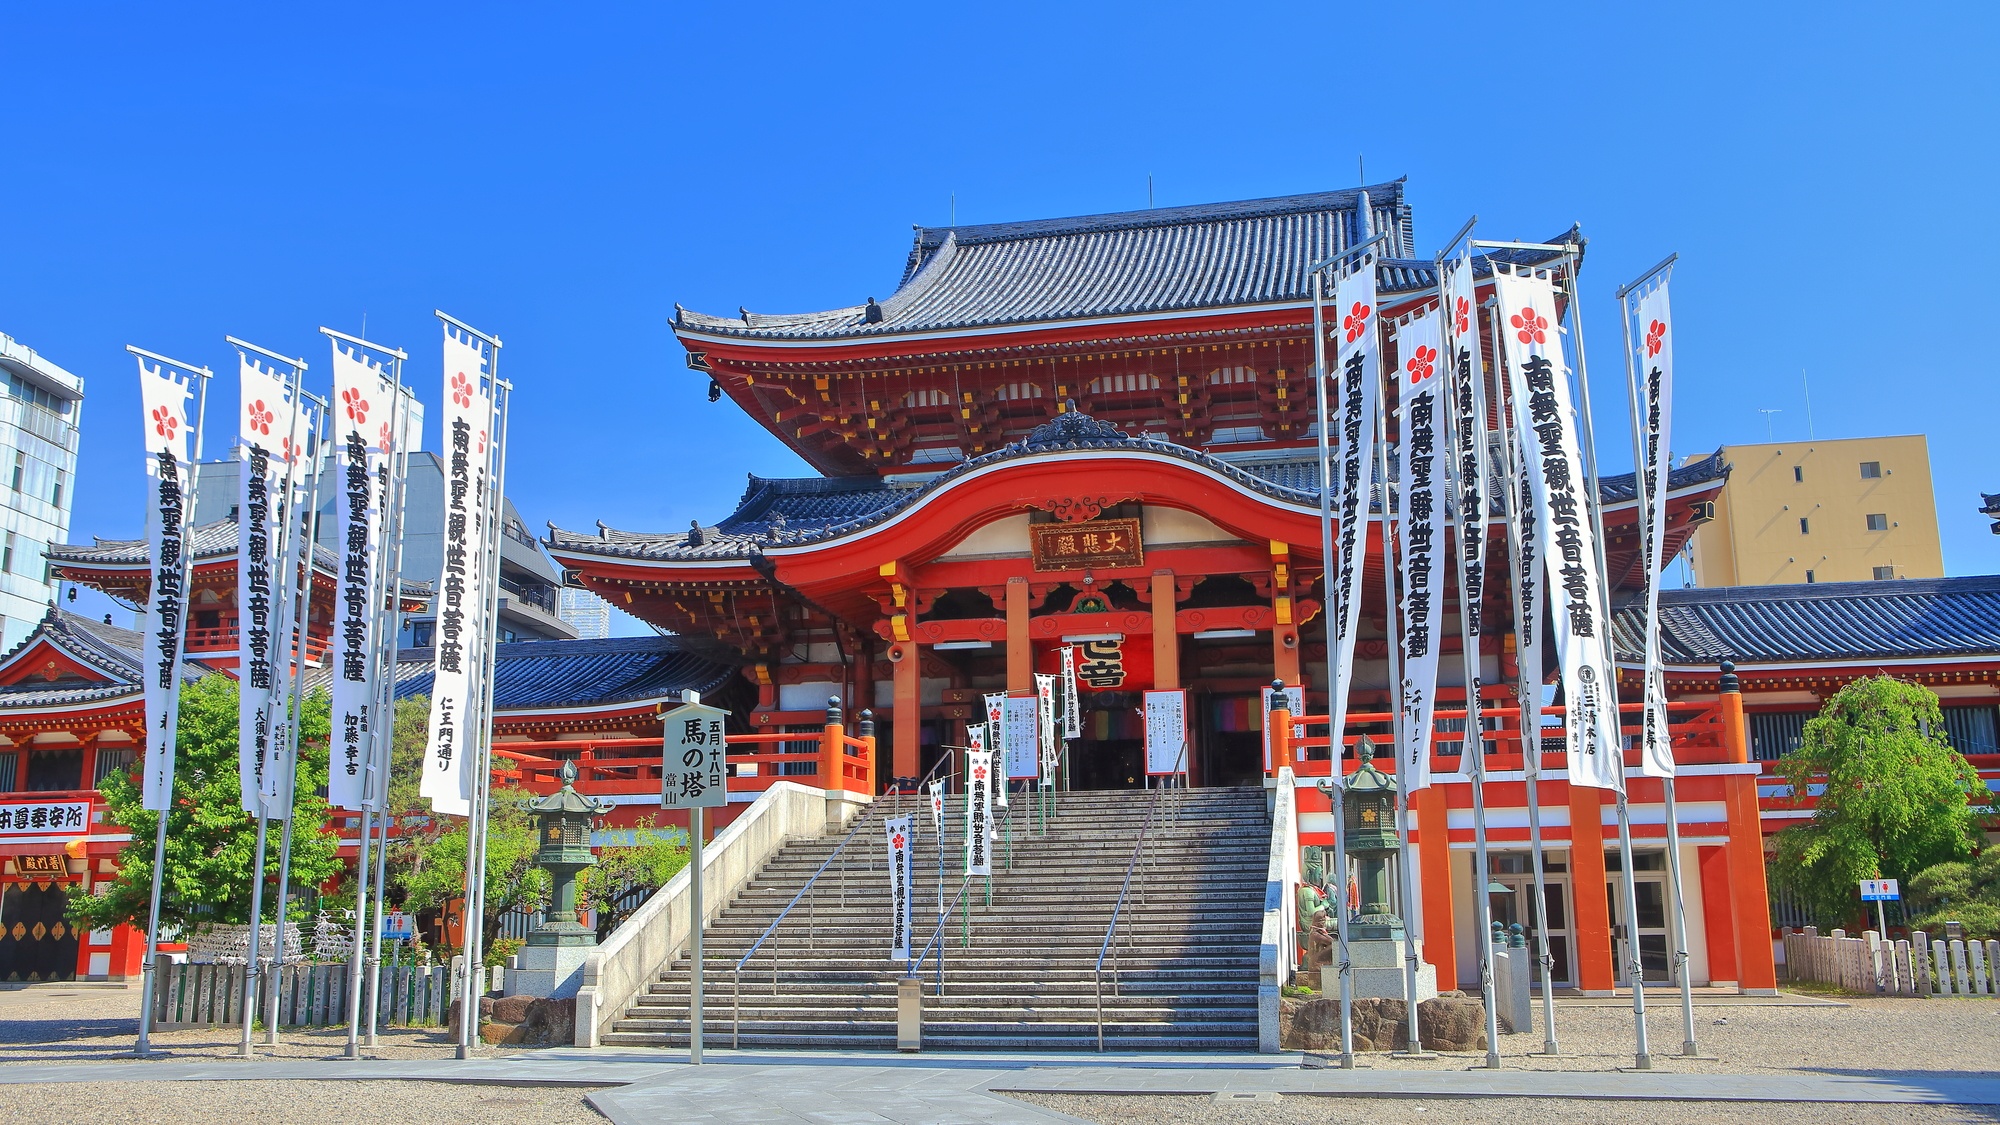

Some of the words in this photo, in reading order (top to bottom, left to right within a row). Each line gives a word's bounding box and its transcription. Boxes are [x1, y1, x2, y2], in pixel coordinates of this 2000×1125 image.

[1521, 354, 1595, 639] 南無聖観世音菩薩
[156, 446, 183, 691] 南無聖観世音菩薩
[248, 442, 271, 691] 南無聖観世音菩薩
[343, 430, 370, 683] 南無聖観世音菩薩
[439, 416, 471, 675] 南無聖観世音菩薩
[344, 710, 359, 776] 加藤幸吉
[437, 696, 454, 772] 仁王門通り
[680, 717, 708, 799] 馬の塔
[709, 720, 721, 788] 五月十八日
[1583, 695, 1597, 756] 三清本店
[665, 773, 677, 805] 當山
[894, 849, 904, 949] 南無聖観世音菩薩
